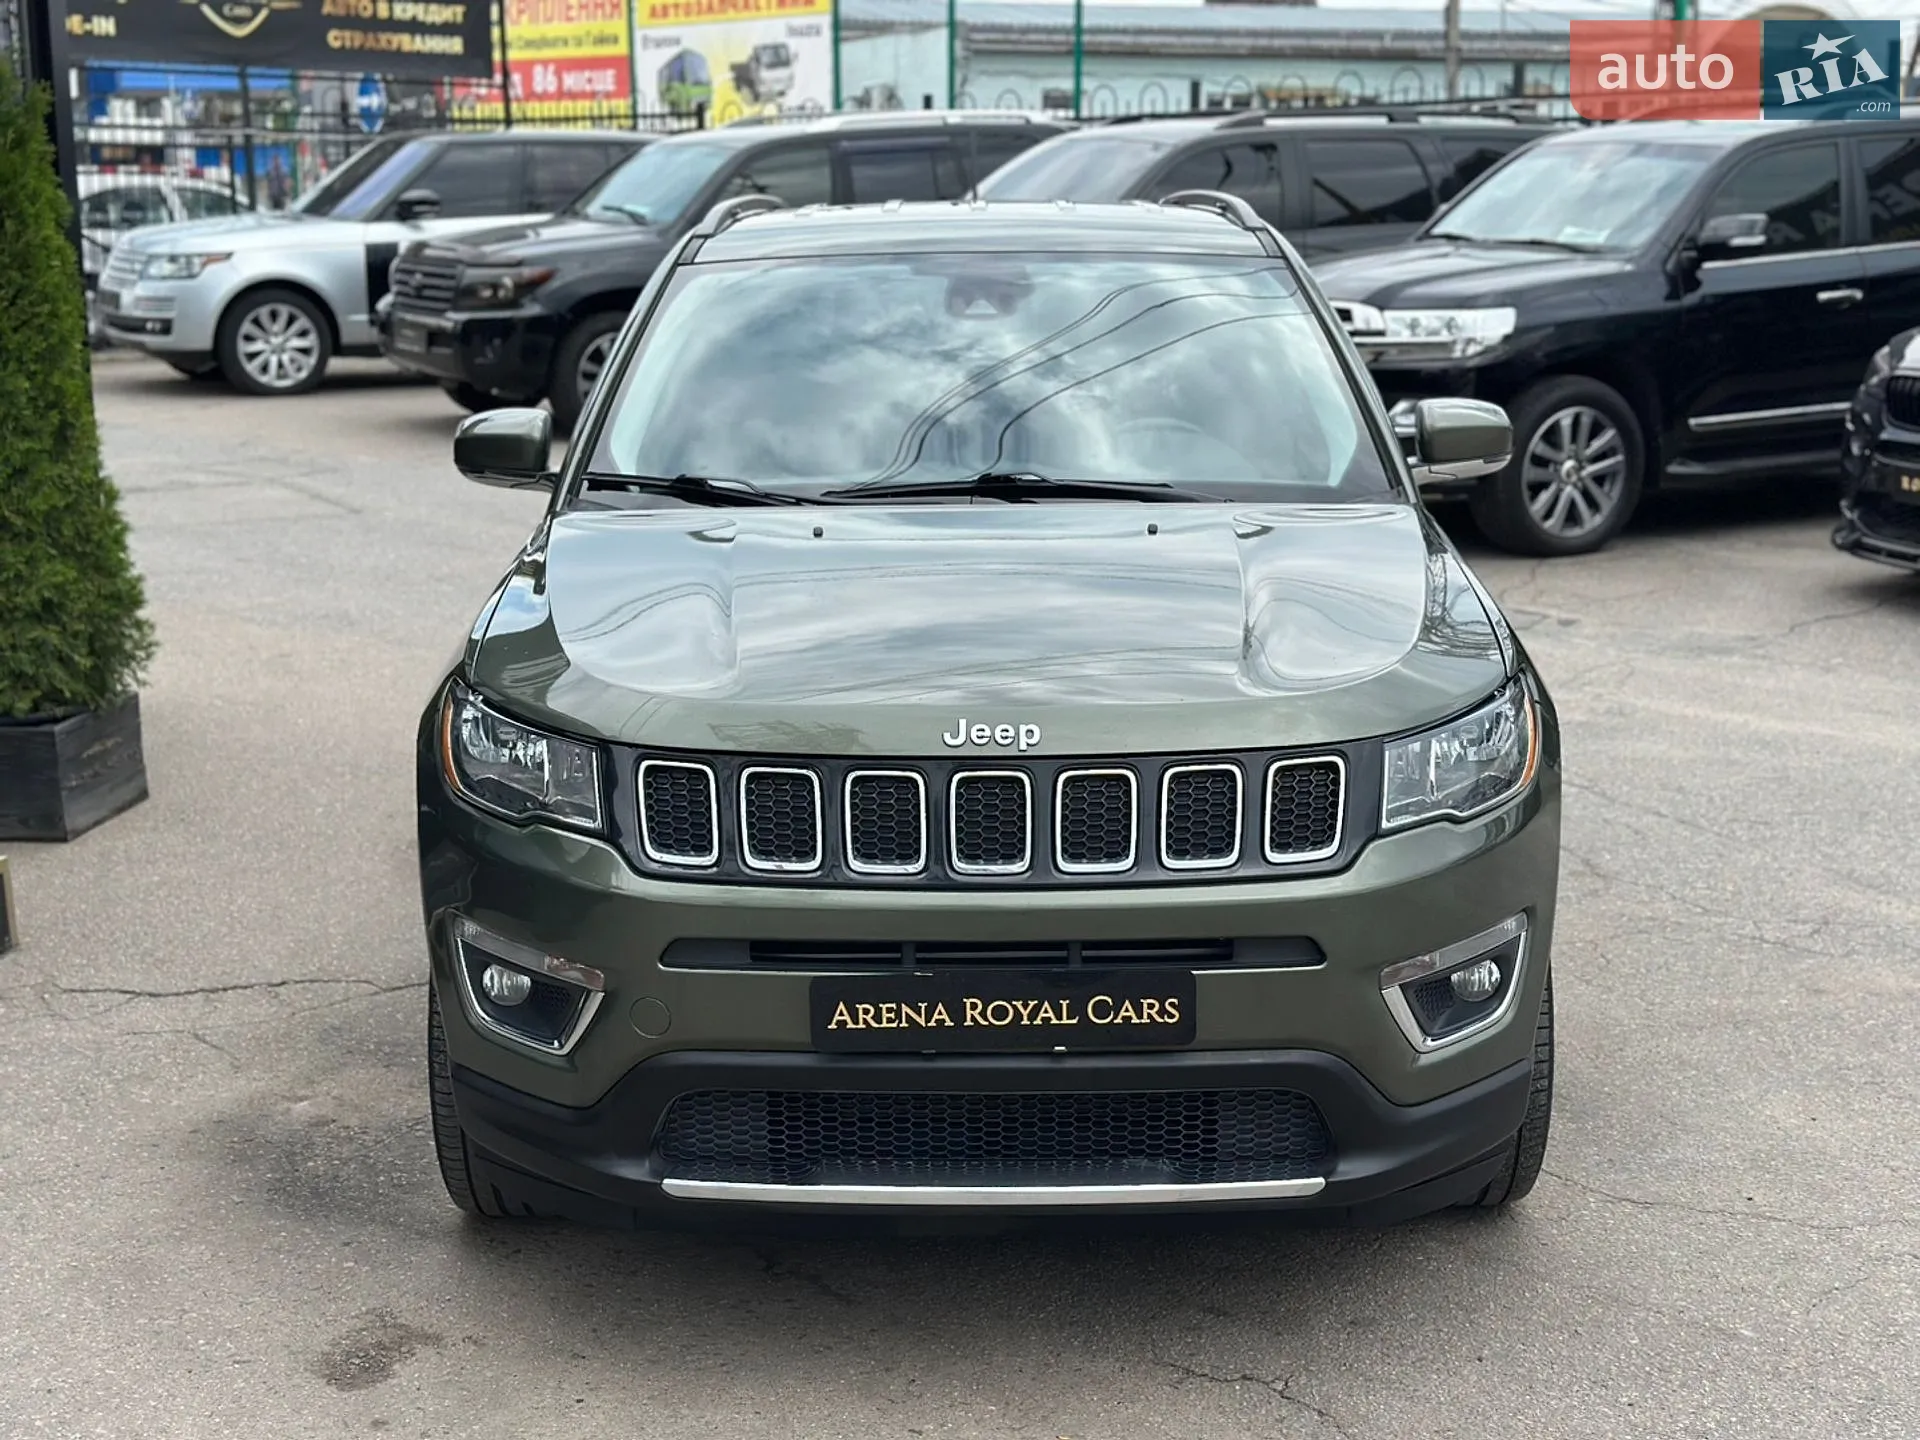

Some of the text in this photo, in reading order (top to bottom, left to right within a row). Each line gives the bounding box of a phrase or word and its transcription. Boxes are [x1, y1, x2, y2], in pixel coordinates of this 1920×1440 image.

[392, 1, 467, 25] КРЕДИТ
[326, 28, 464, 55] СТРАХУВАННЯ
[531, 62, 559, 95] 86
[942, 718, 1042, 752] Jeep
[827, 995, 1181, 1030] ARENA ROYAL CARS
